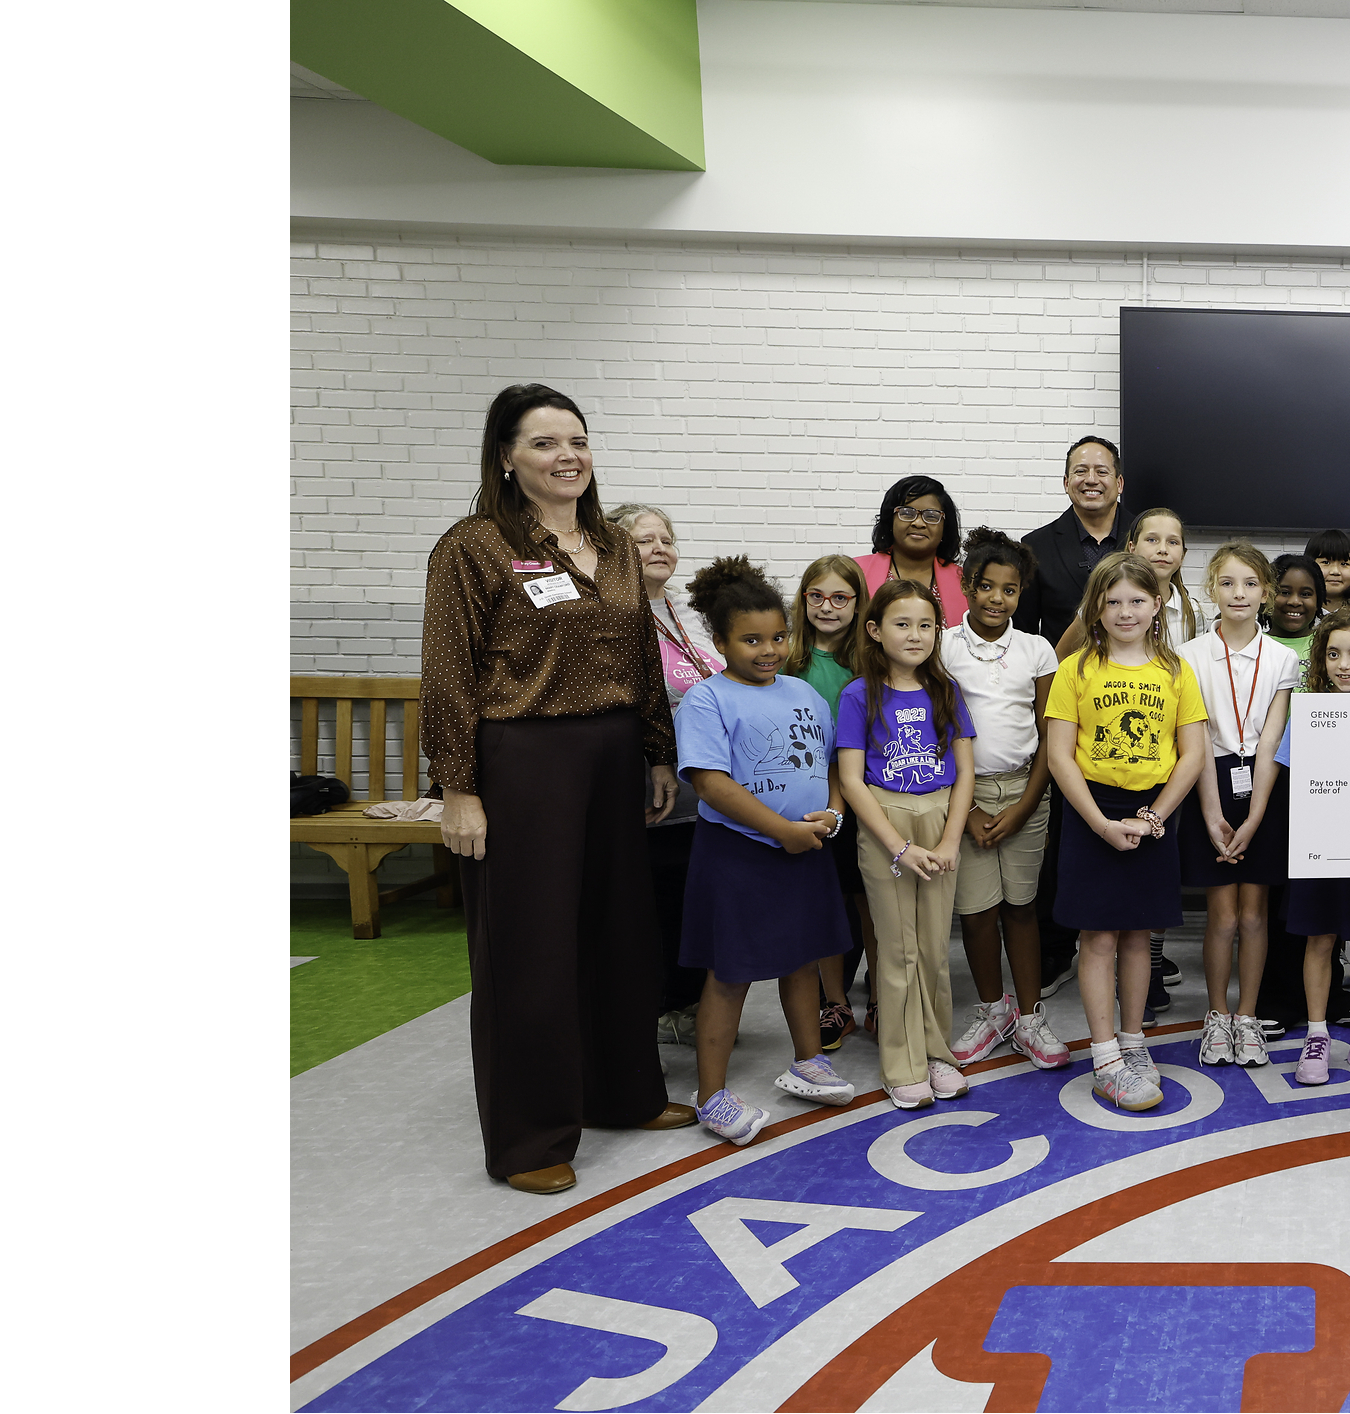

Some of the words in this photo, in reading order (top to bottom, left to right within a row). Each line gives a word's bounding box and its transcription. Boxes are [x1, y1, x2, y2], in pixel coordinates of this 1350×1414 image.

[1138, 683, 1161, 692] SMITH
[1093, 692, 1130, 710] ROAR
[1139, 693, 1165, 710] RUN
[895, 707, 926, 724] 2023
[766, 778, 787, 792] Day
[1309, 780, 1321, 789] Pay
